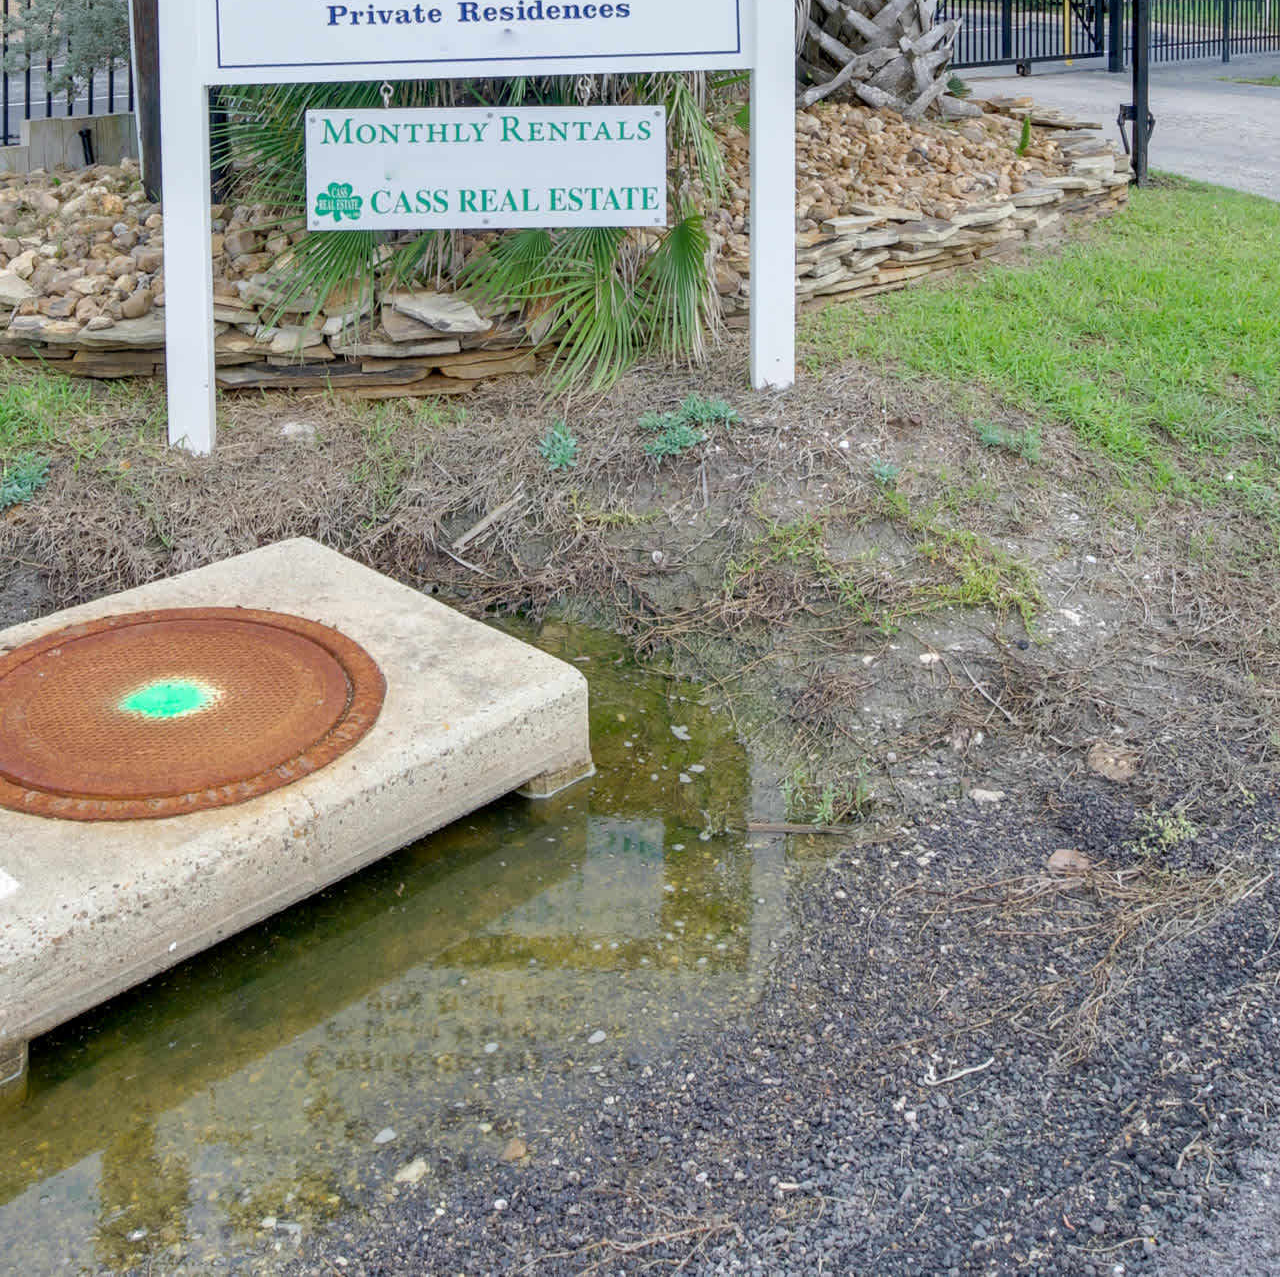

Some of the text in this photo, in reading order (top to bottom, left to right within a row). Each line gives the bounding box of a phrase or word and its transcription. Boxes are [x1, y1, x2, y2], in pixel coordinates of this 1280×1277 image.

[326, 0, 631, 26] Private Residences
[320, 115, 652, 145] MONTHLY RENTALS
[331, 186, 348, 199] CASS
[370, 186, 659, 215] CASS REAL ESTATE
